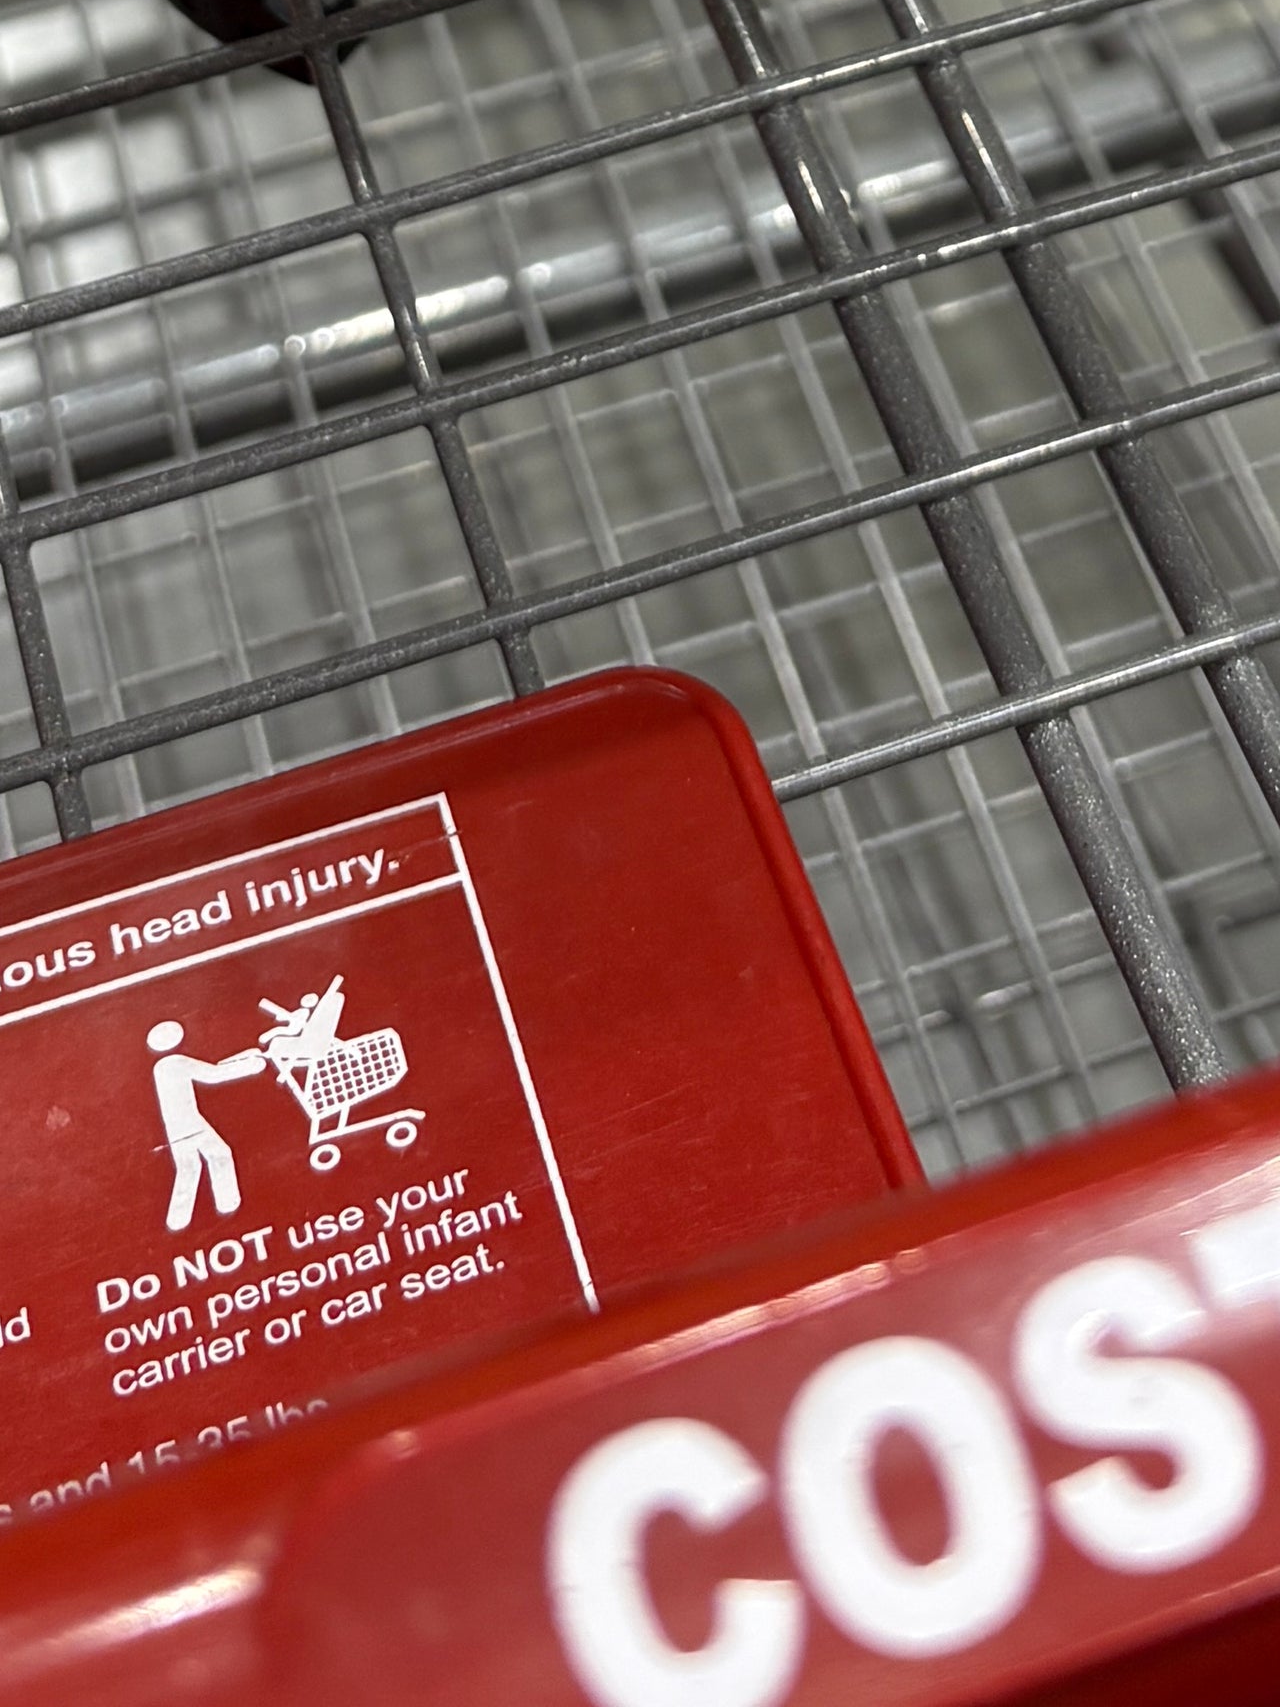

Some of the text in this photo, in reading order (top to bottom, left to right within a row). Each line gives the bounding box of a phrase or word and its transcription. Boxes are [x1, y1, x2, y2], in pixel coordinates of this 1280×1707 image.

[111, 891, 233, 960] head
[245, 848, 401, 913] injury.
[96, 1168, 469, 1314] Do NOT use your
[104, 1190, 523, 1354] own personal infant
[112, 1243, 505, 1396] carrier or car seat.
